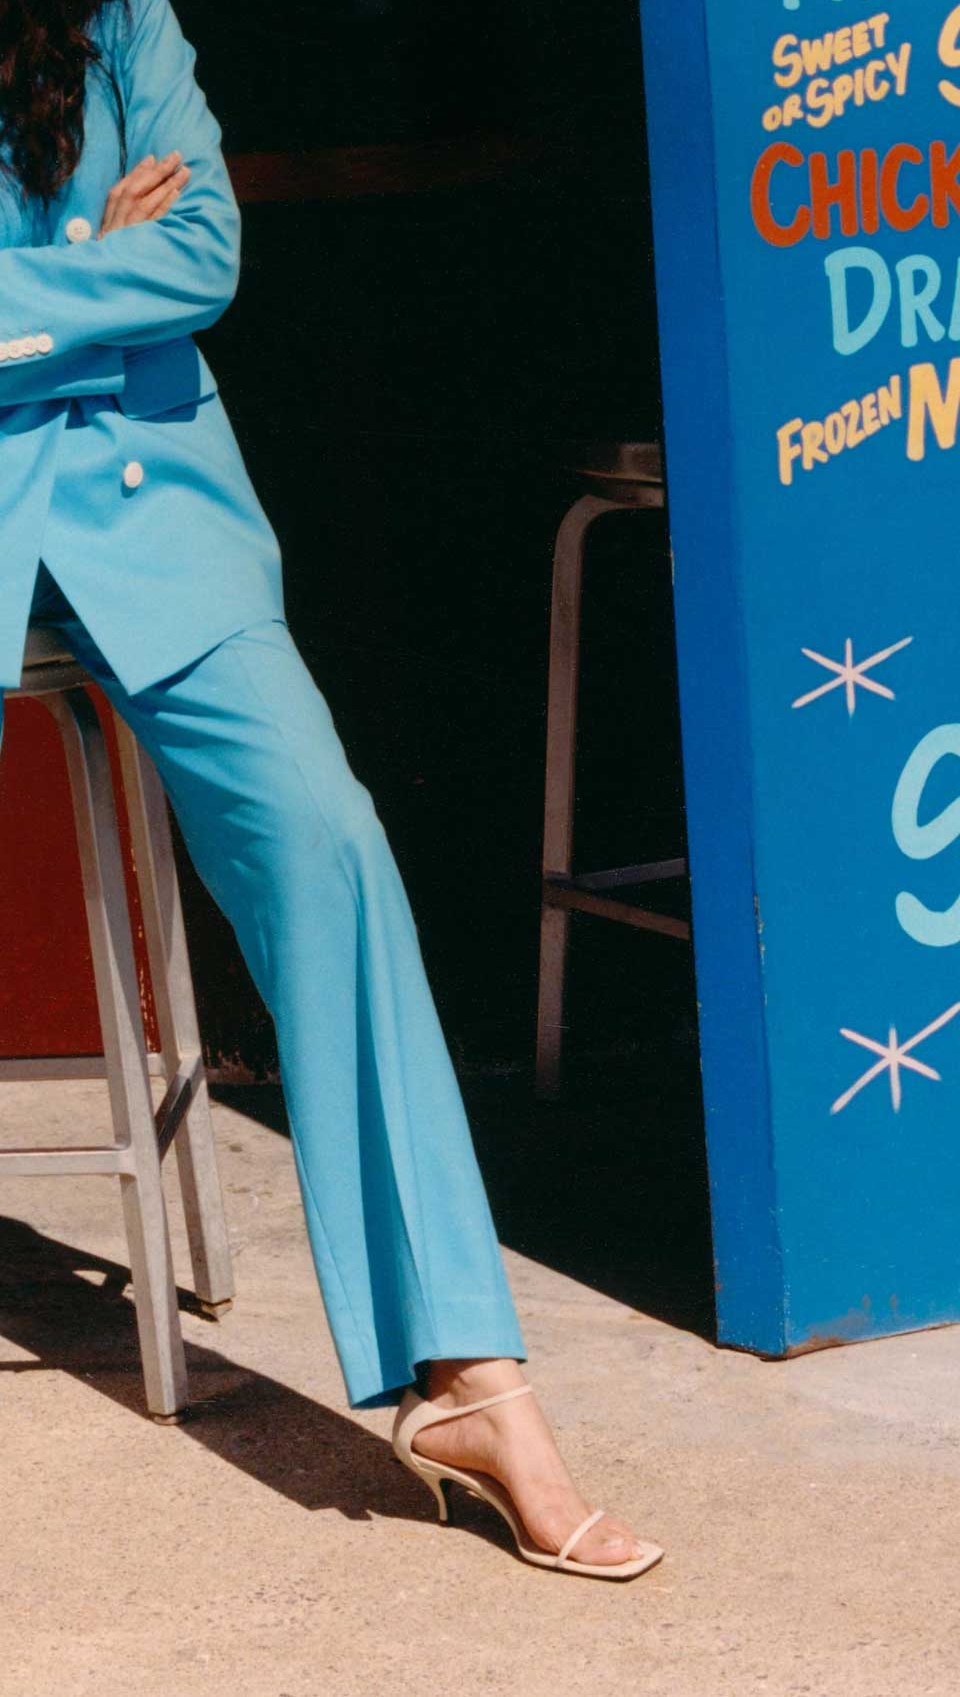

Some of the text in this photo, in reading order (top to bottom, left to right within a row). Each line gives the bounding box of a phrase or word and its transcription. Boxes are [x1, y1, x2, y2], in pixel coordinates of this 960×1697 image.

[772, 12, 890, 88] SWEET
[806, 42, 912, 128] SPICY
[750, 140, 960, 247] CHICK
[824, 246, 960, 356] DR
[776, 374, 902, 486] FROZEN
